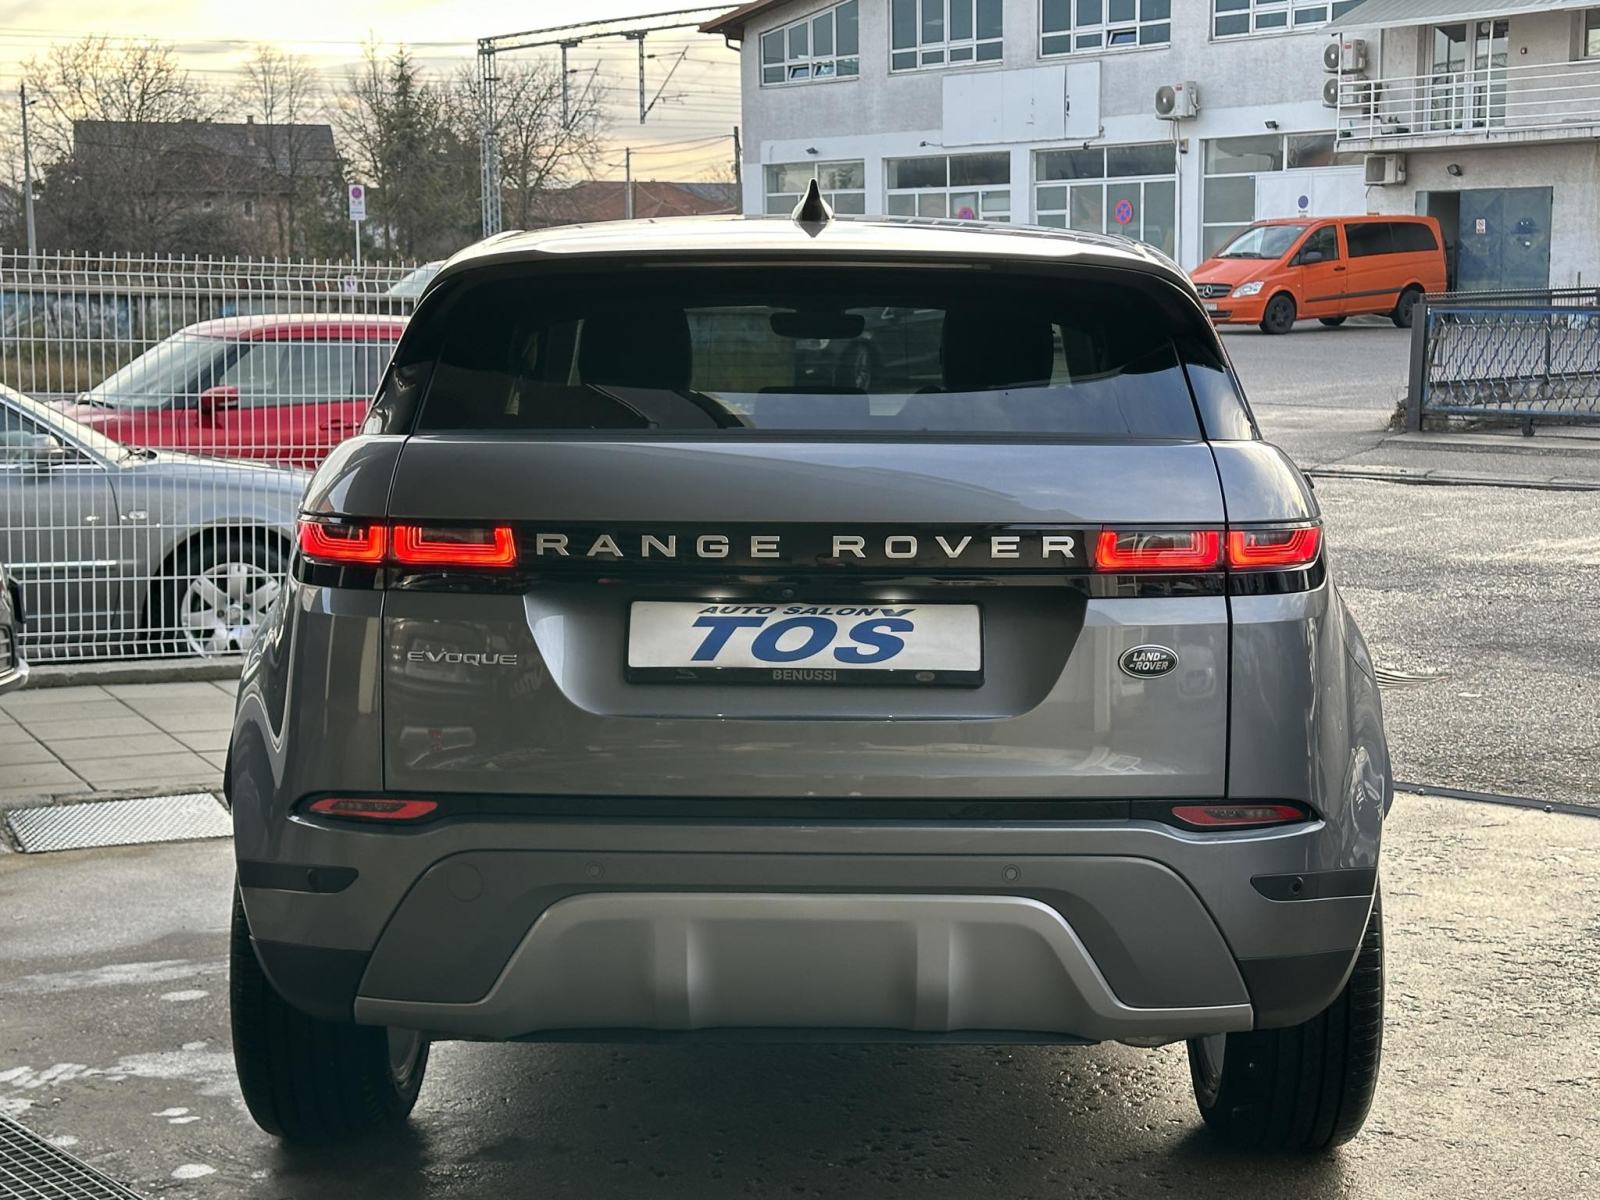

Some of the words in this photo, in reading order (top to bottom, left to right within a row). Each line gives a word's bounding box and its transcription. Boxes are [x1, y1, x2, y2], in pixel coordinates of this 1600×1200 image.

[536, 533, 780, 558] RANGE
[832, 535, 1075, 559] ROVER
[698, 605, 778, 616] AUTO
[782, 606, 881, 617] SALON
[407, 651, 518, 666] EVOQUE
[1132, 652, 1161, 661] LAND
[1134, 661, 1169, 670] ROVER
[772, 669, 837, 682] BENUSSI
